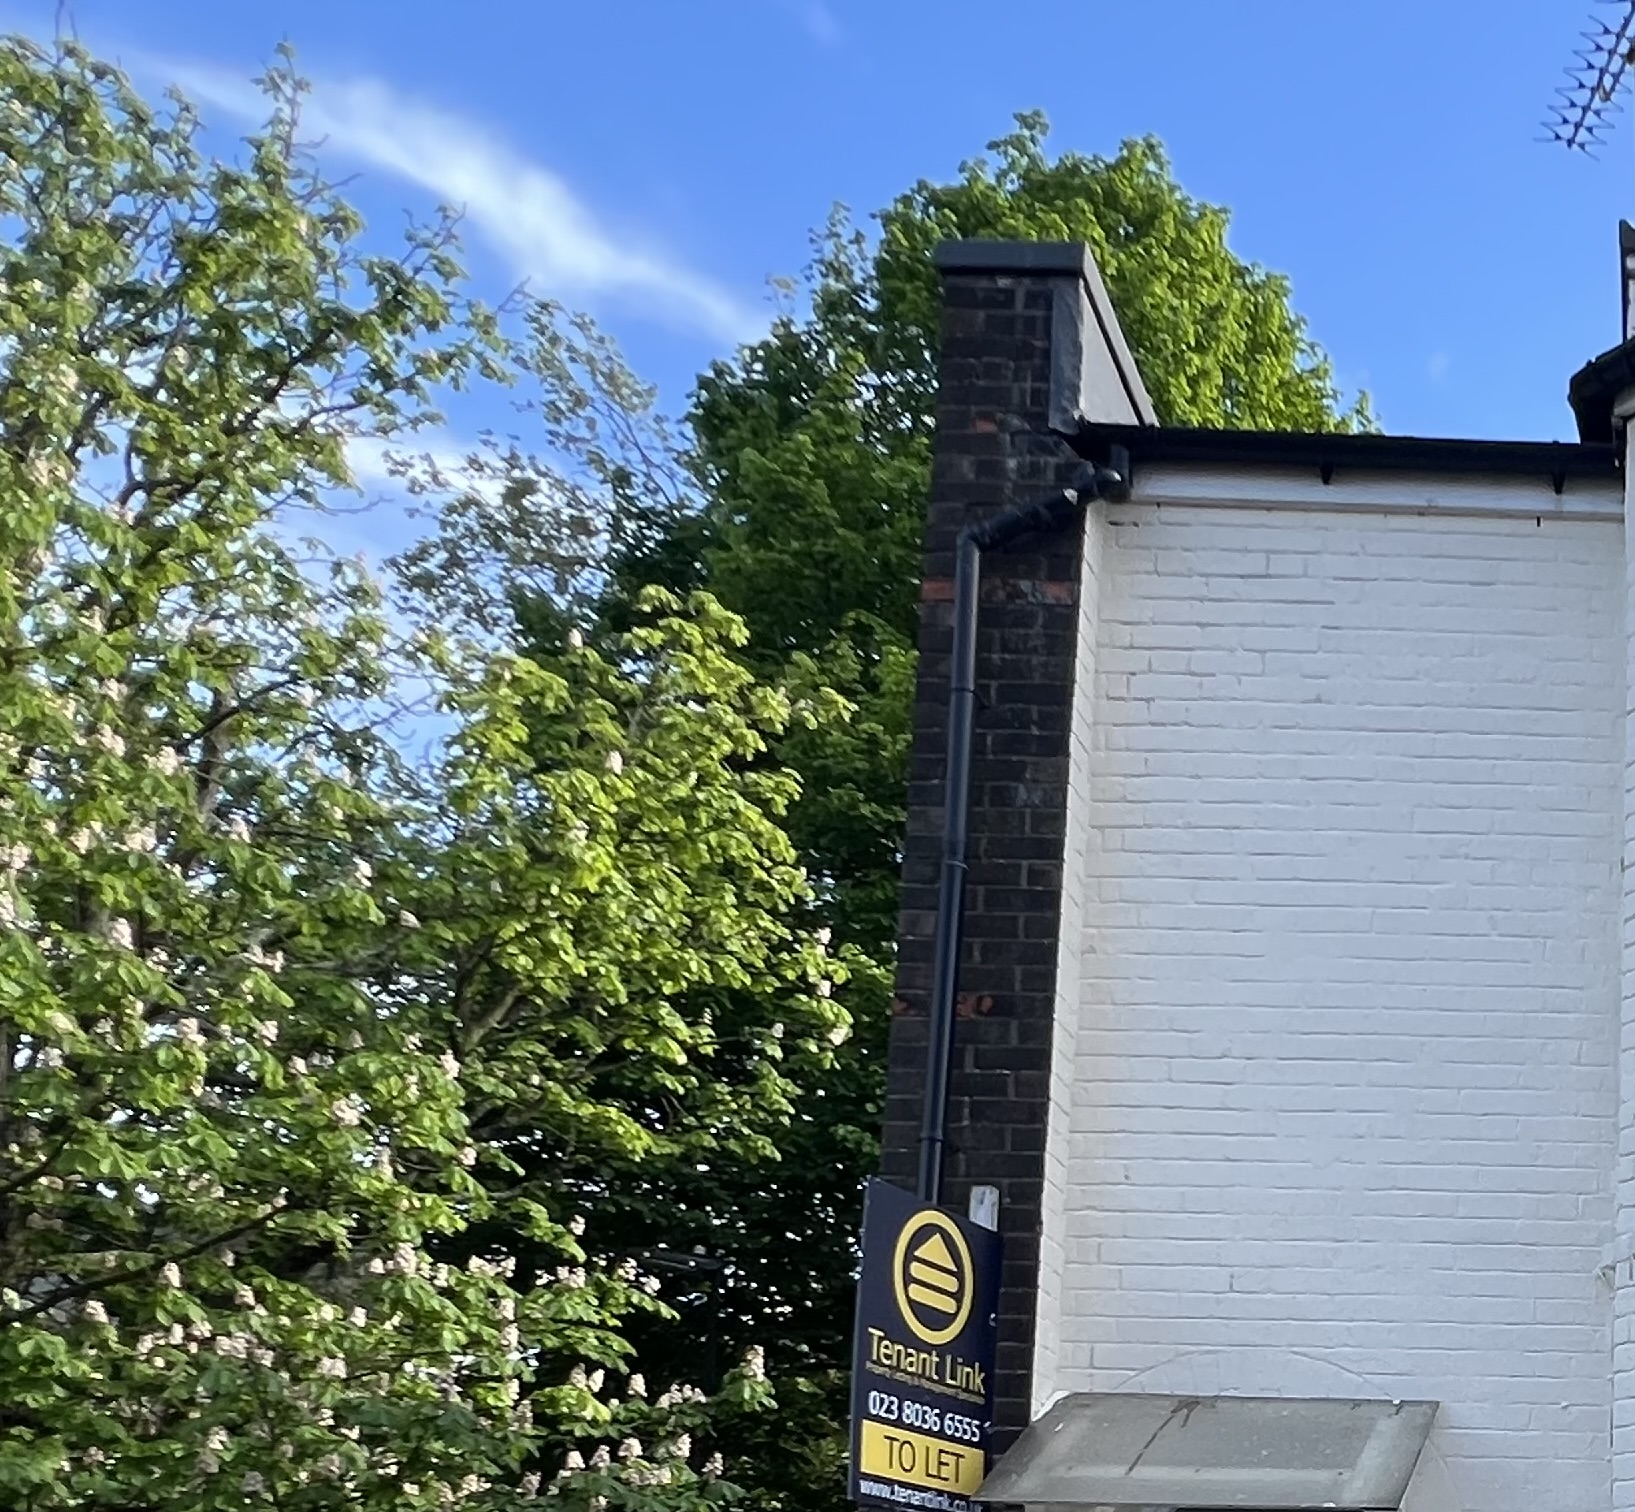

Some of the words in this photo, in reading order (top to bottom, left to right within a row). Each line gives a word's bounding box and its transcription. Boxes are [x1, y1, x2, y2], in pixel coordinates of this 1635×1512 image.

[868, 1327, 940, 1380] Tenant
[945, 1354, 986, 1395] Link
[868, 1390, 899, 1420] 023
[902, 1401, 941, 1432] 8036
[944, 1412, 981, 1442] 6555
[883, 1435, 916, 1473] TO
[925, 1446, 966, 1484] LET
